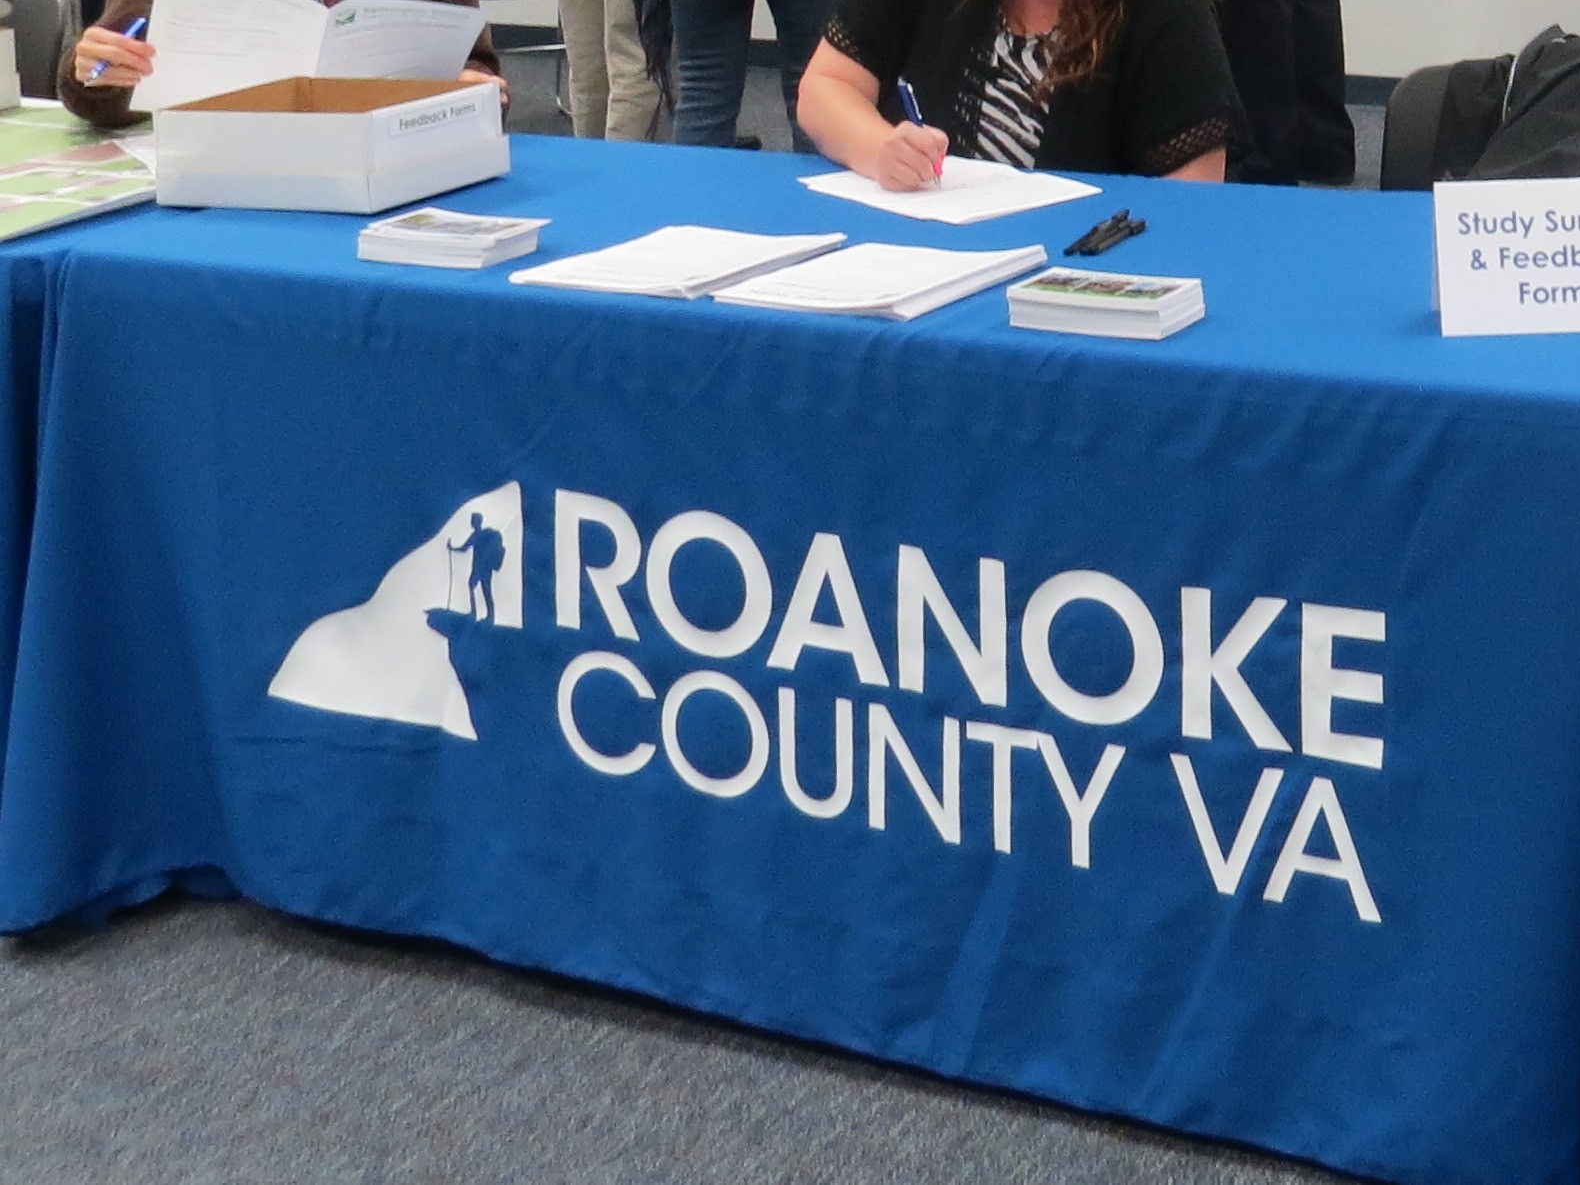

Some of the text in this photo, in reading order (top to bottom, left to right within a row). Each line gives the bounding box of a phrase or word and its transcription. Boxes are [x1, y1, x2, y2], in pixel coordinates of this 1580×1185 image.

[399, 102, 478, 129] Feedback Forms
[1457, 210, 1535, 239] Study
[1470, 248, 1488, 271] &
[554, 488, 1386, 770] ROANOKE
[557, 650, 1382, 923] COUNTY VA
